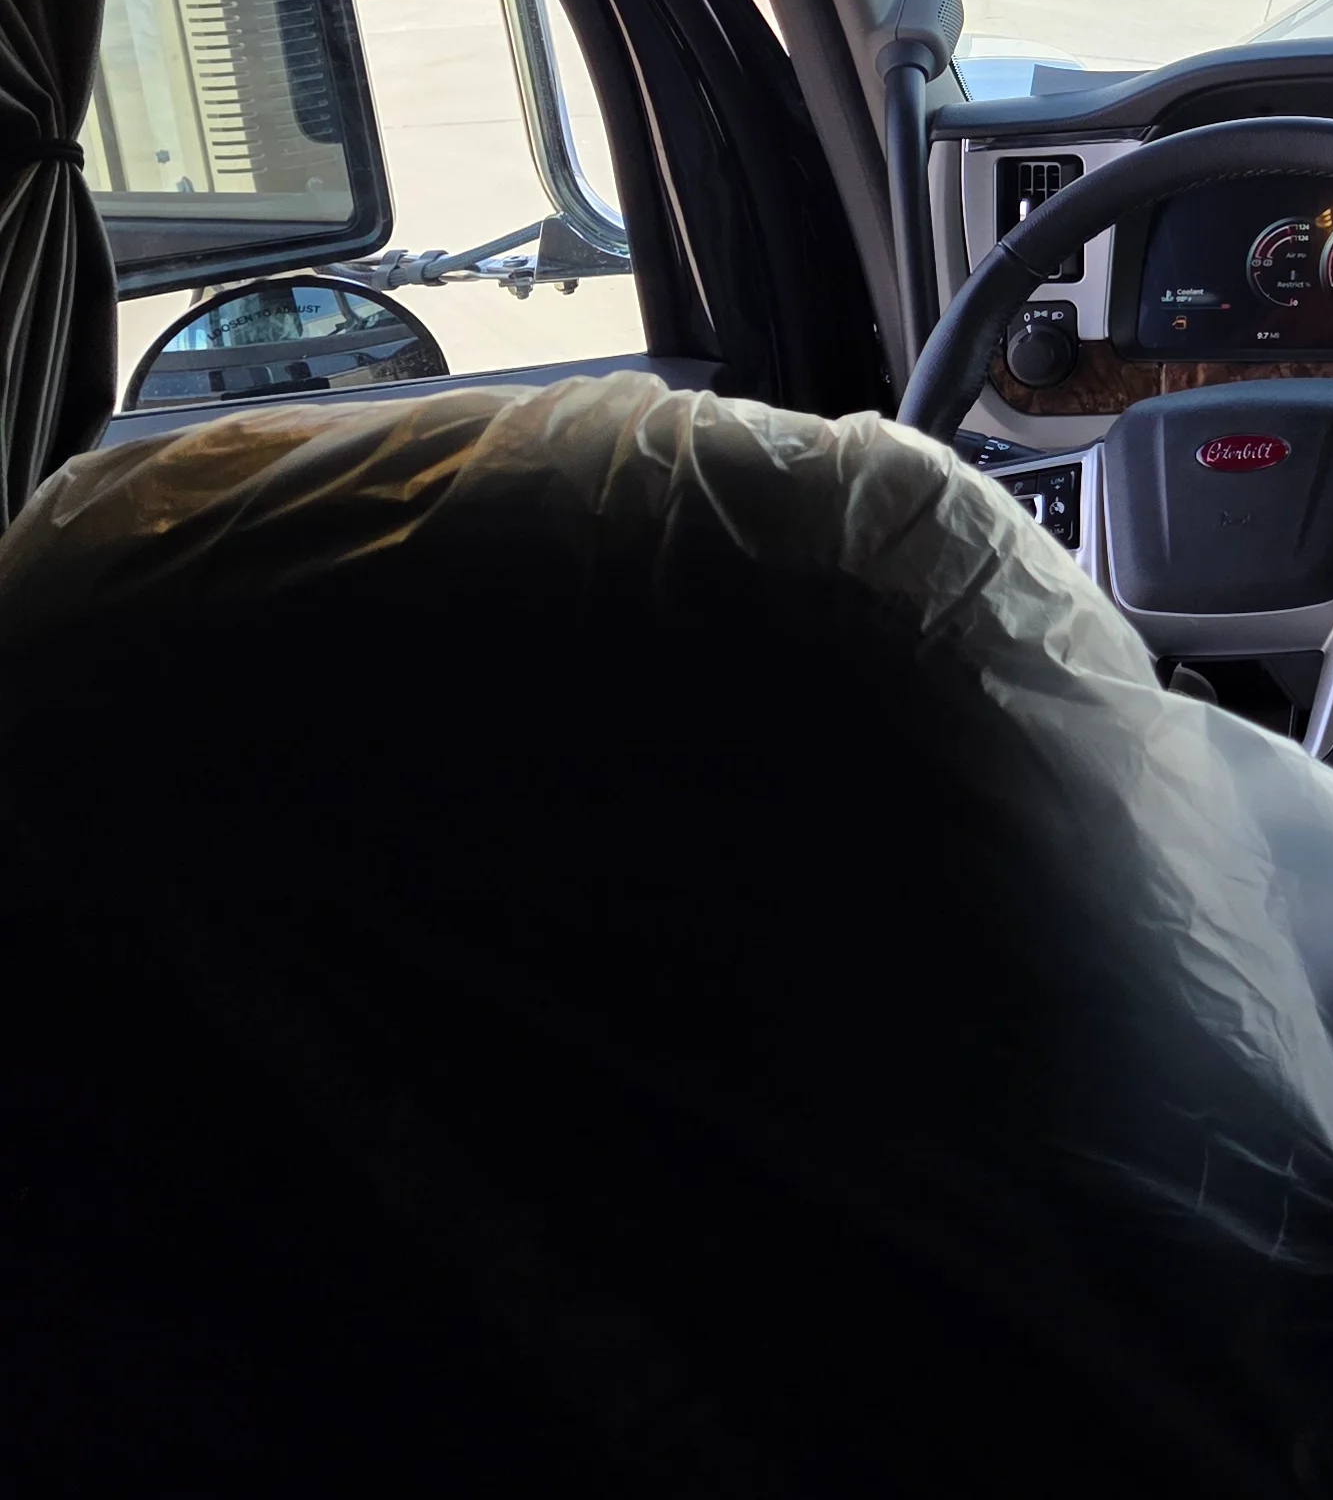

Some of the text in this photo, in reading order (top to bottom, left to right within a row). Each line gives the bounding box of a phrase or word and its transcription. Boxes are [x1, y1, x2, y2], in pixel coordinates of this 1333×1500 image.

[1276, 280, 1304, 288] Restrict
[206, 313, 253, 342] LOOSEN
[254, 309, 272, 318] TO
[1256, 331, 1269, 339] 9.7
[1206, 442, 1273, 462] Peterbilt
[1050, 476, 1065, 485] LIM
